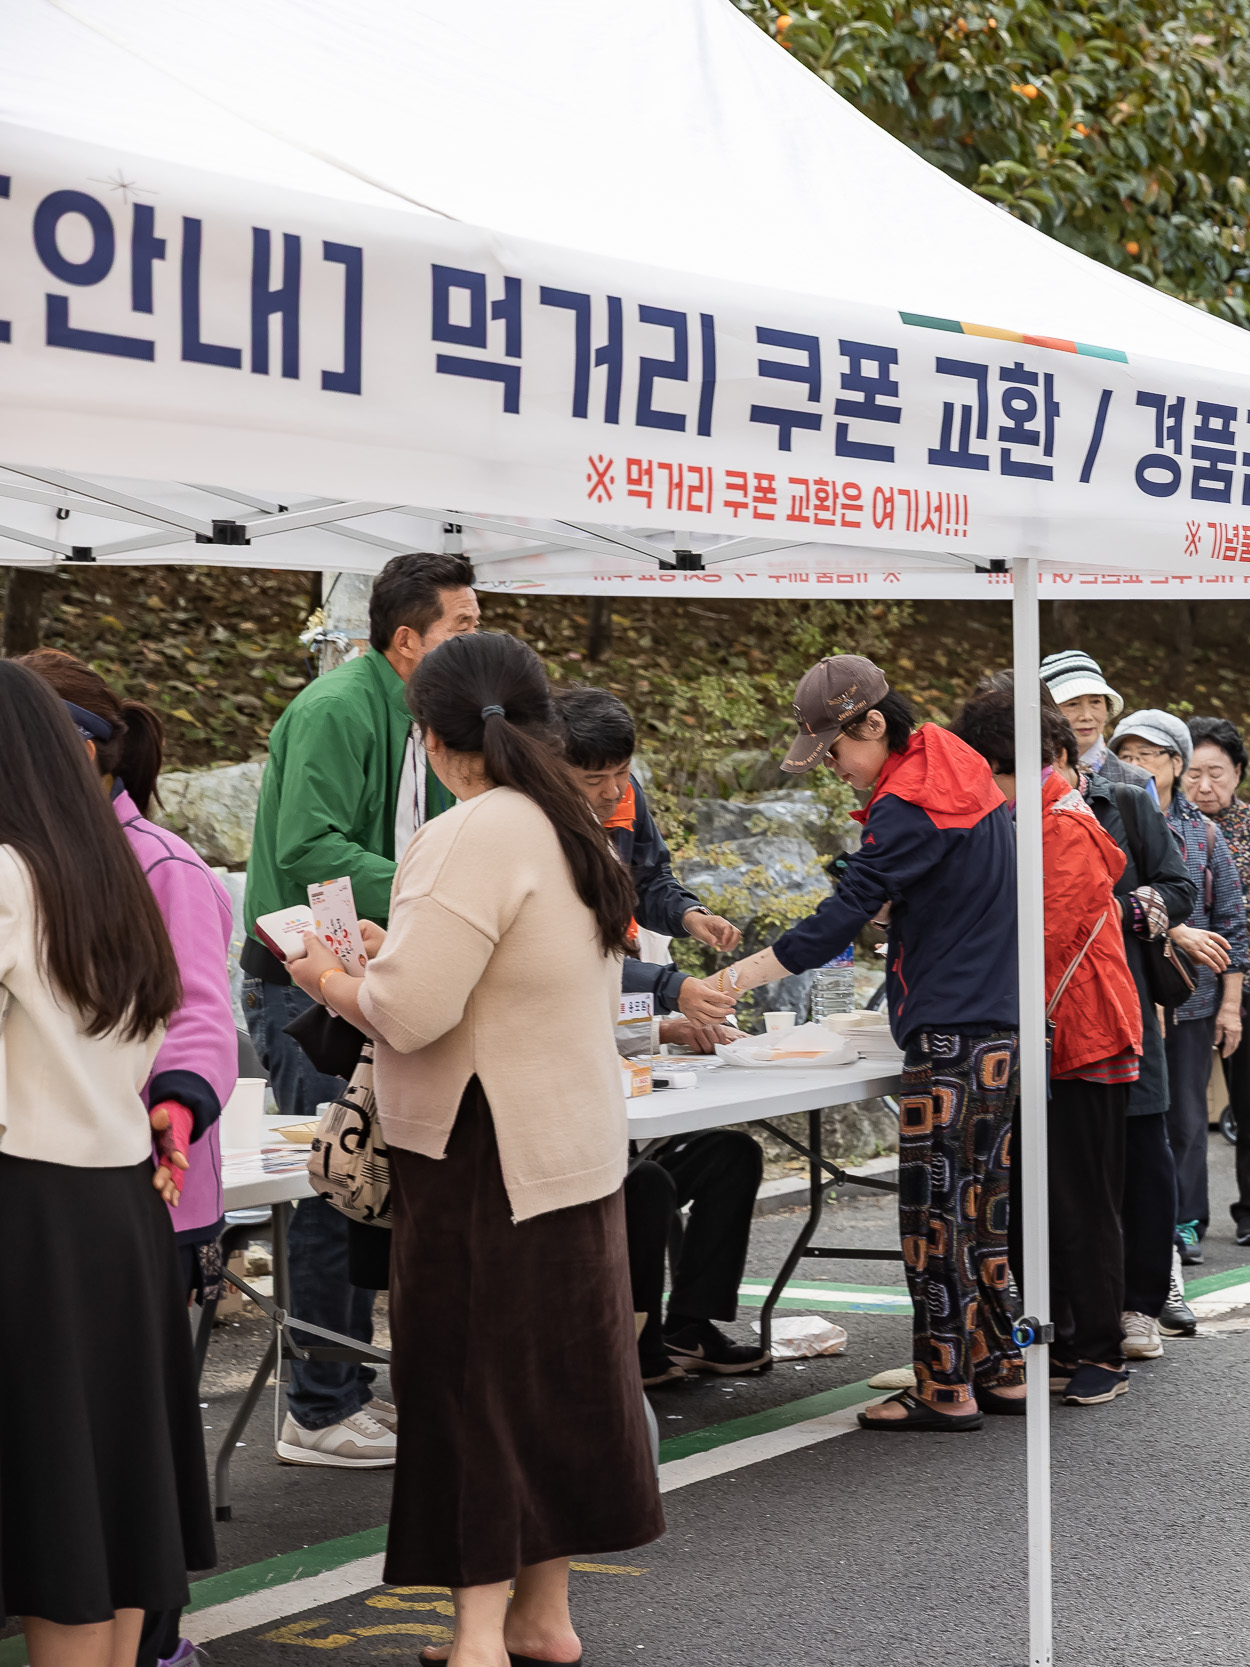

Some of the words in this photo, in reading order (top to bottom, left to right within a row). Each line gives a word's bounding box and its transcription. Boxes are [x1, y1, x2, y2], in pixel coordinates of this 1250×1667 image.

[0, 175, 363, 395] 안내]
[431, 264, 715, 437] 먹거리
[749, 325, 902, 462] 쿠폰
[928, 356, 1060, 481] 교환
[625, 458, 713, 514] 먹거리
[723, 470, 777, 521] 쿠폰
[786, 477, 863, 529] 교환은
[873, 486, 969, 537] 여기서!!!
